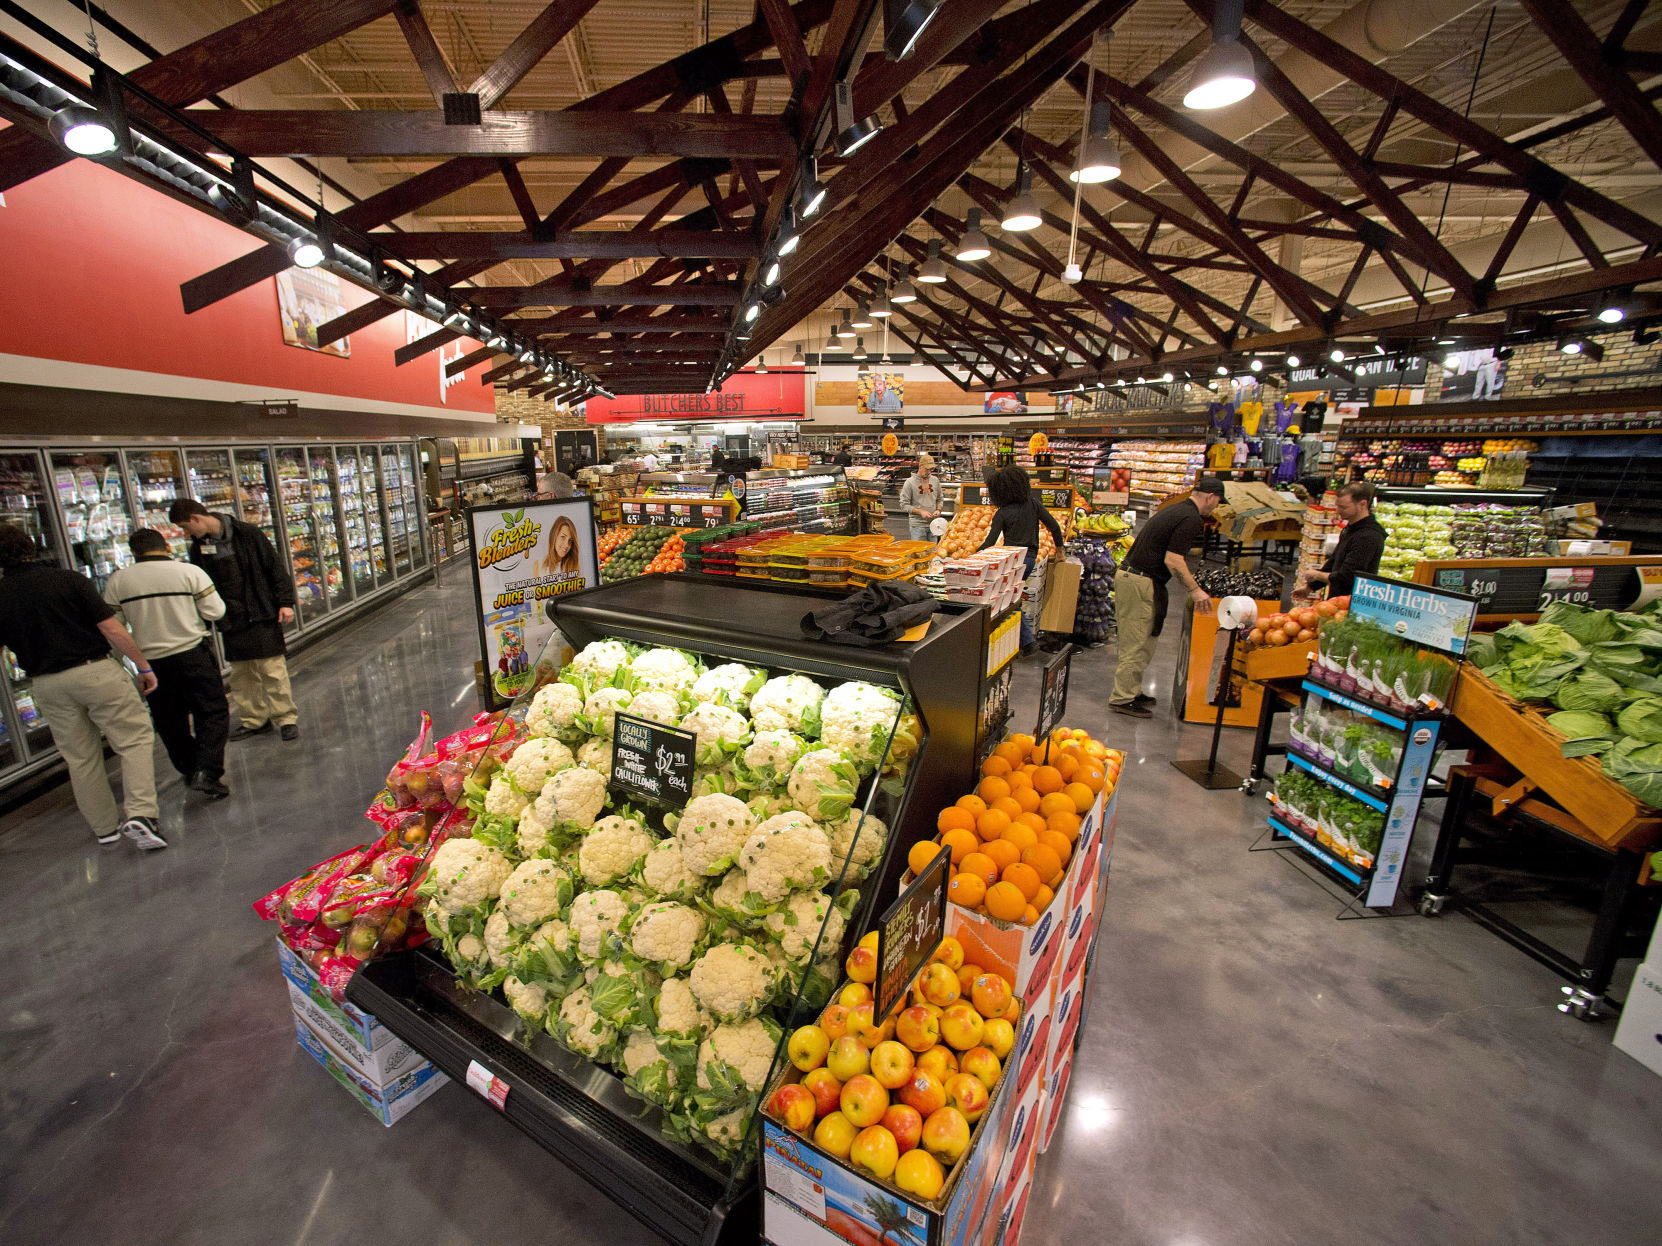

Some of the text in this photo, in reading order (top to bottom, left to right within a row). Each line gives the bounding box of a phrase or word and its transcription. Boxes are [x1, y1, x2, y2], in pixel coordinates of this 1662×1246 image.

[644, 393, 745, 412] BUTCHERS BEST
[491, 517, 534, 548] Fresh
[478, 533, 538, 569] Blenders
[494, 578, 586, 609] JUICE OR SMOOTHIE!
[505, 583, 516, 592] THE
[516, 577, 542, 590] NATURAL
[542, 574, 560, 585] START
[568, 570, 579, 580] ANY
[1351, 594, 1422, 620] GROWN IN VIRGINIA
[1354, 576, 1449, 617] Fresh Herbs
[1329, 690, 1343, 703] Snip
[1350, 700, 1373, 715] needed
[619, 722, 648, 740] LOCALLY
[620, 732, 648, 751] GROWN
[617, 747, 645, 762] FRESH
[623, 759, 647, 774] WHITE
[614, 766, 688, 796] CAULIFLOWER each
[1311, 764, 1357, 795] Enjoy every day
